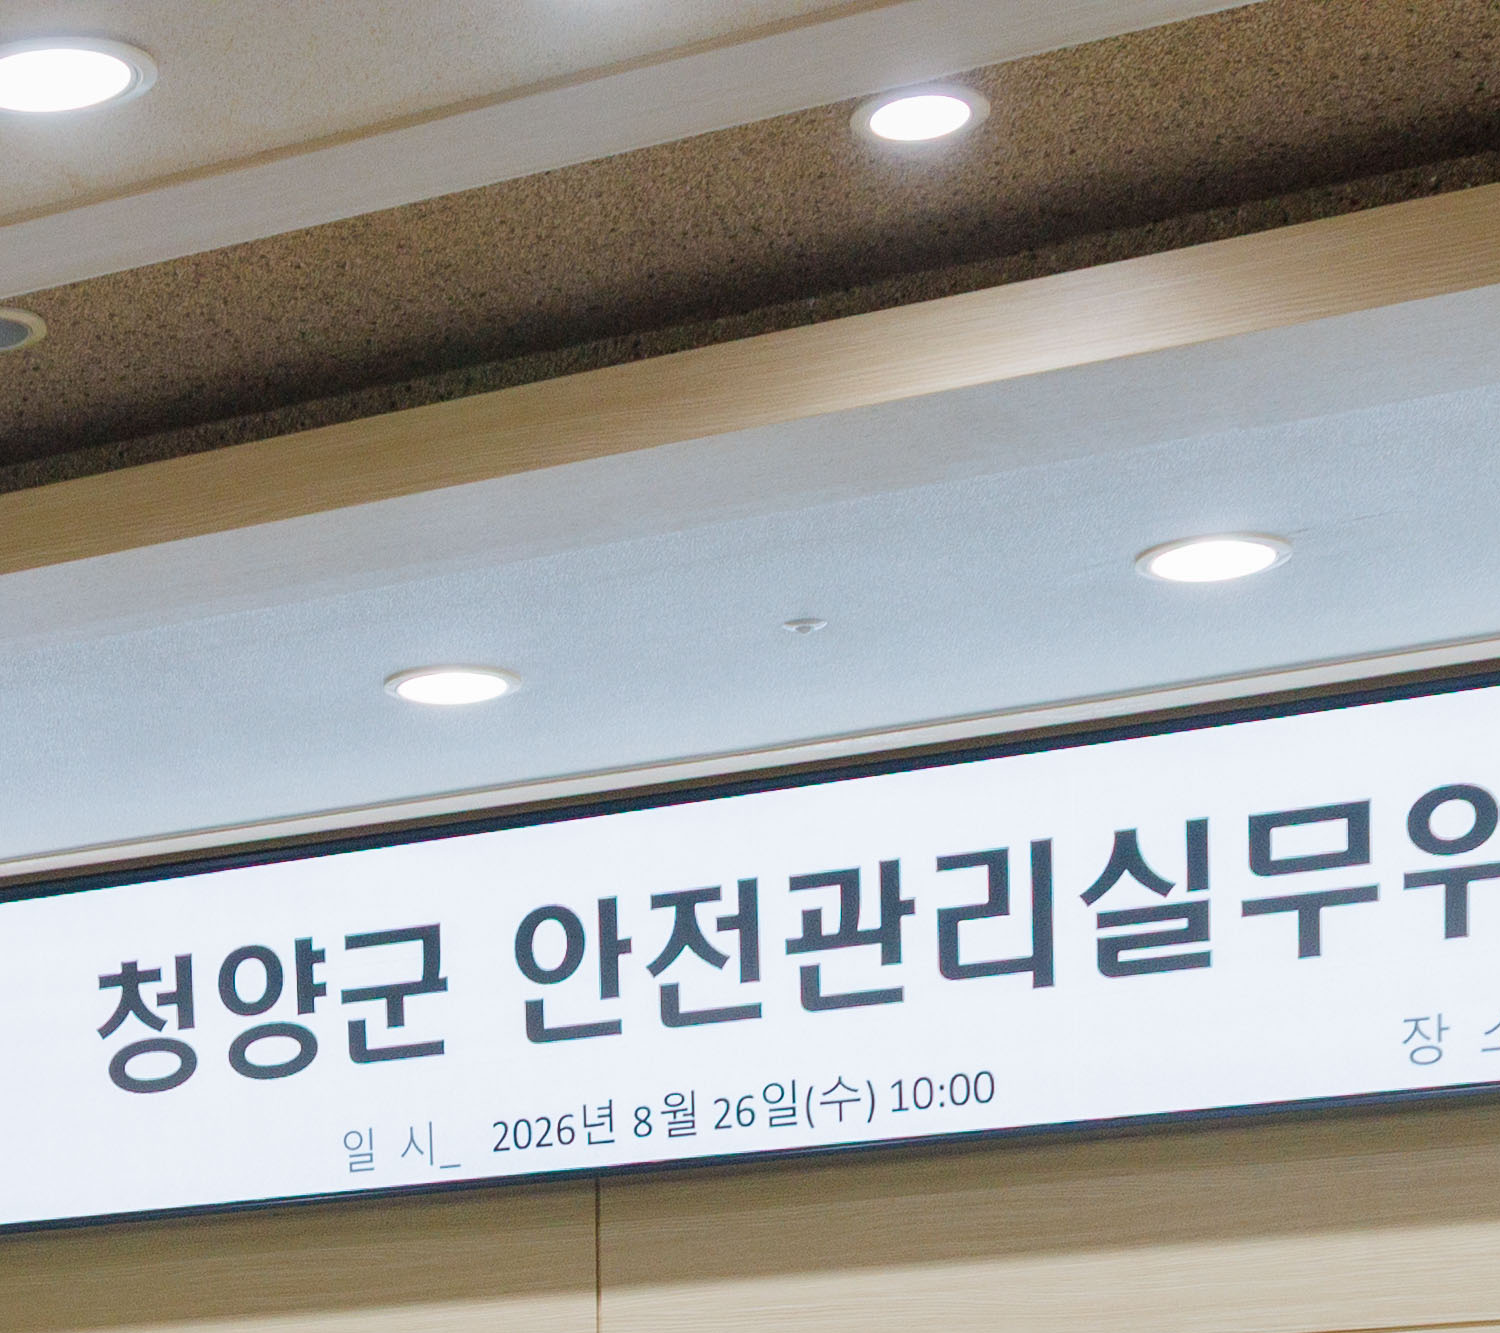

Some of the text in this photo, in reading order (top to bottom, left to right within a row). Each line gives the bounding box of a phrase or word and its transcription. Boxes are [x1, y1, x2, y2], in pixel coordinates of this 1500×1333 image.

[97, 923, 449, 1094] 청양군
[1402, 1013, 1449, 1065] 장
[343, 1126, 375, 1172] 일
[492, 1099, 616, 1153] 2026년
[633, 1090, 698, 1138] 8월
[713, 1075, 876, 1131] 26일(수)
[890, 1070, 996, 1113] 10:00
